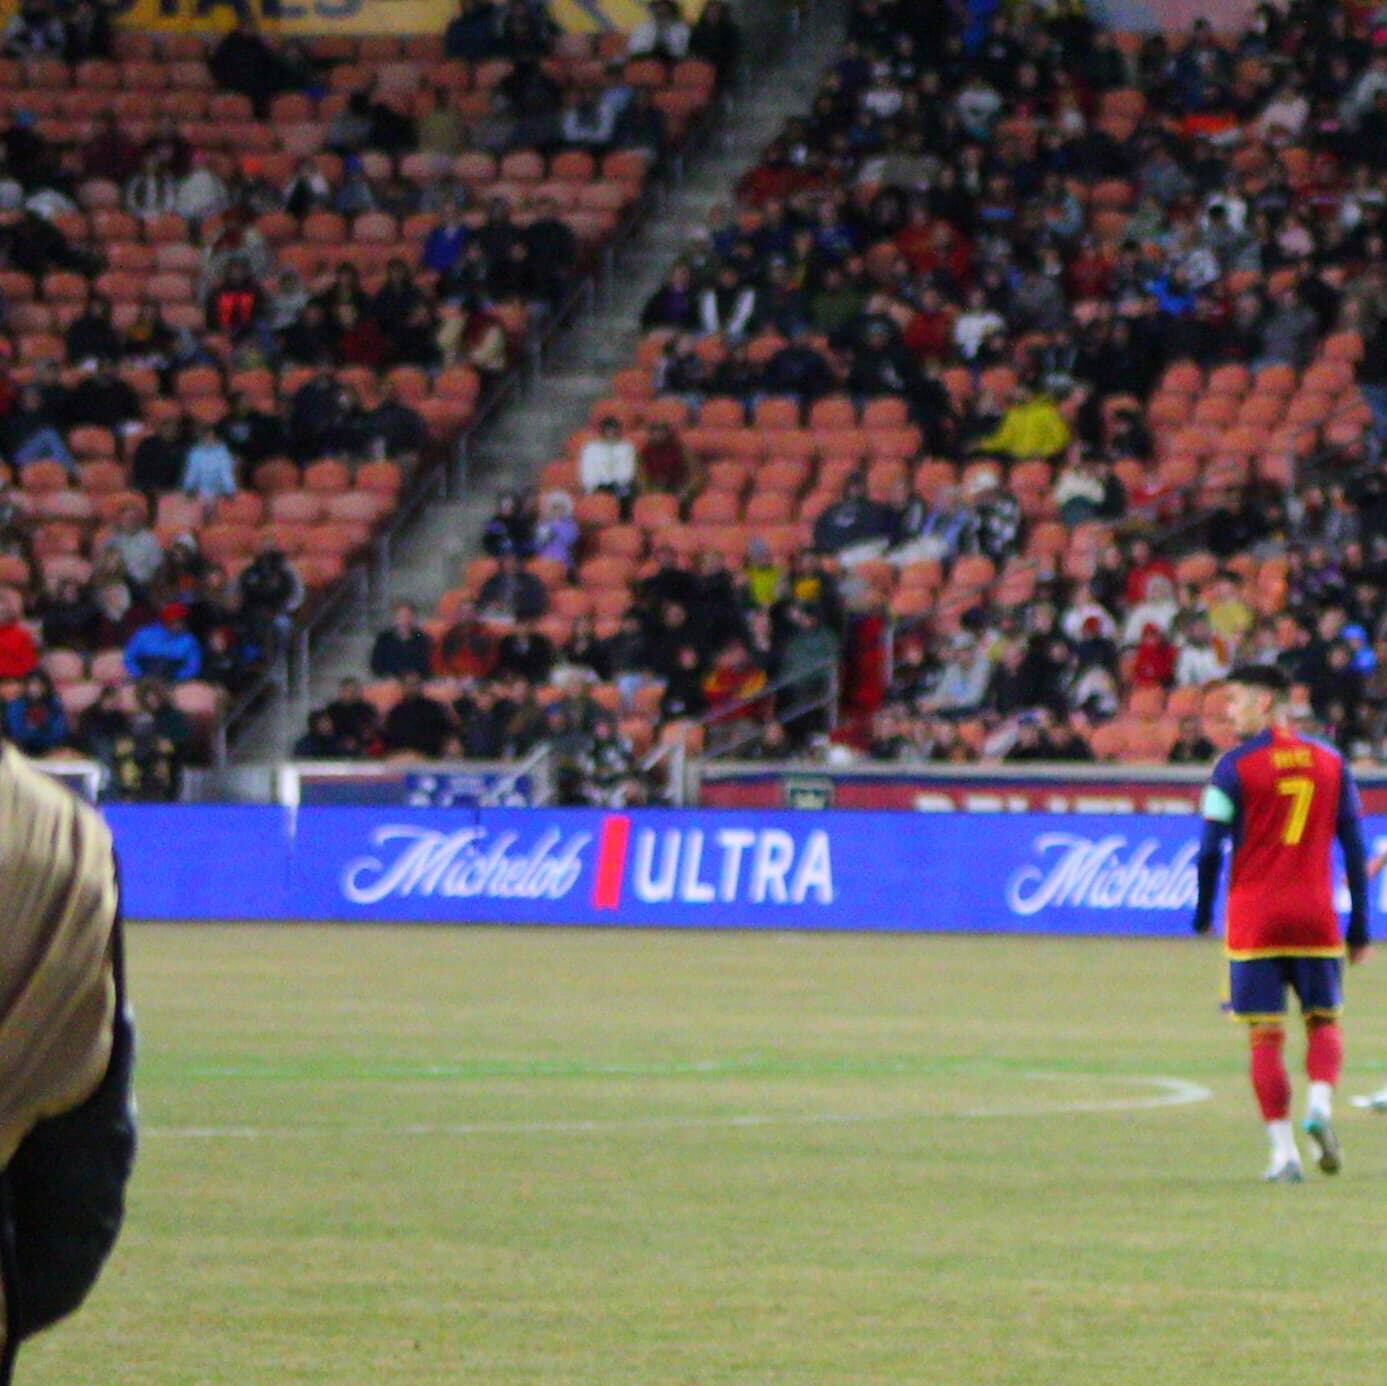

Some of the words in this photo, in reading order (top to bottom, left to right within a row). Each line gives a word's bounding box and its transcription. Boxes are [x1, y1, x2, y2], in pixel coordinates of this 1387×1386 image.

[1279, 777, 1315, 846] 7
[345, 824, 591, 905] Michelob
[635, 827, 834, 904] ULTRA
[1008, 832, 1202, 916] Michelo
